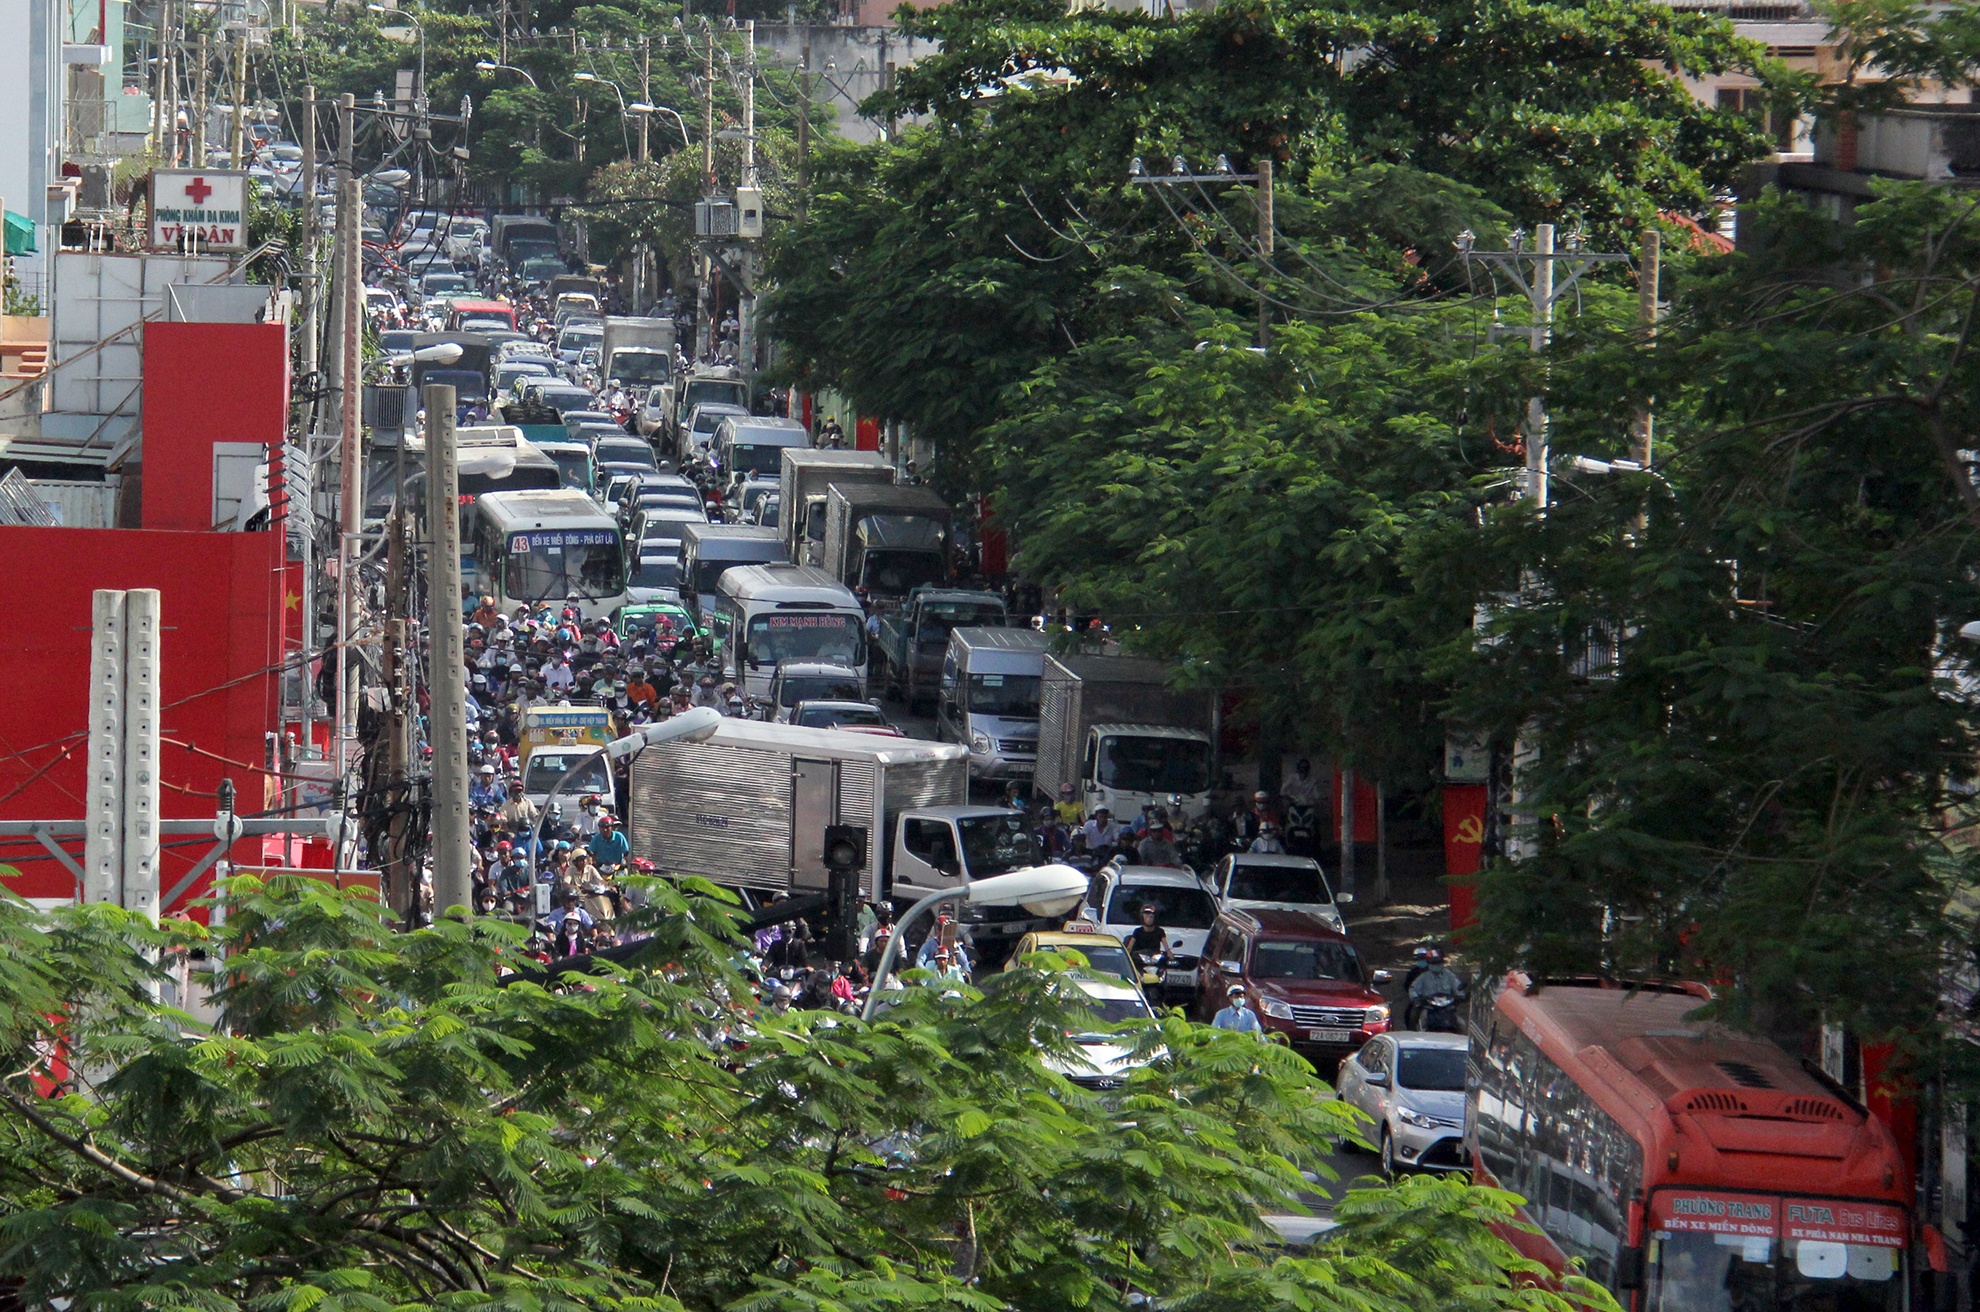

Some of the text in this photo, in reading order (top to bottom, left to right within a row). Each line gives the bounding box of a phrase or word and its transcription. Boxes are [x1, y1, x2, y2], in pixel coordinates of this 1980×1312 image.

[183, 206, 205, 223] KHÁM
[219, 210, 240, 223] KHOA
[513, 537, 529, 552] 43
[543, 536, 550, 546] XE
[769, 614, 846, 630] KIM MẠNH HÙNG
[1673, 1197, 1772, 1220] PHƯƠNG TRANG
[1664, 1216, 1688, 1229] BẾN
[1690, 1220, 1706, 1230] XE
[1787, 1204, 1900, 1232] FUTA Bus Lines
[1791, 1228, 1804, 1238] BX
[1829, 1231, 1850, 1241] NAM
[1851, 1232, 1871, 1243] NHA
[1873, 1235, 1903, 1246] TRANG
